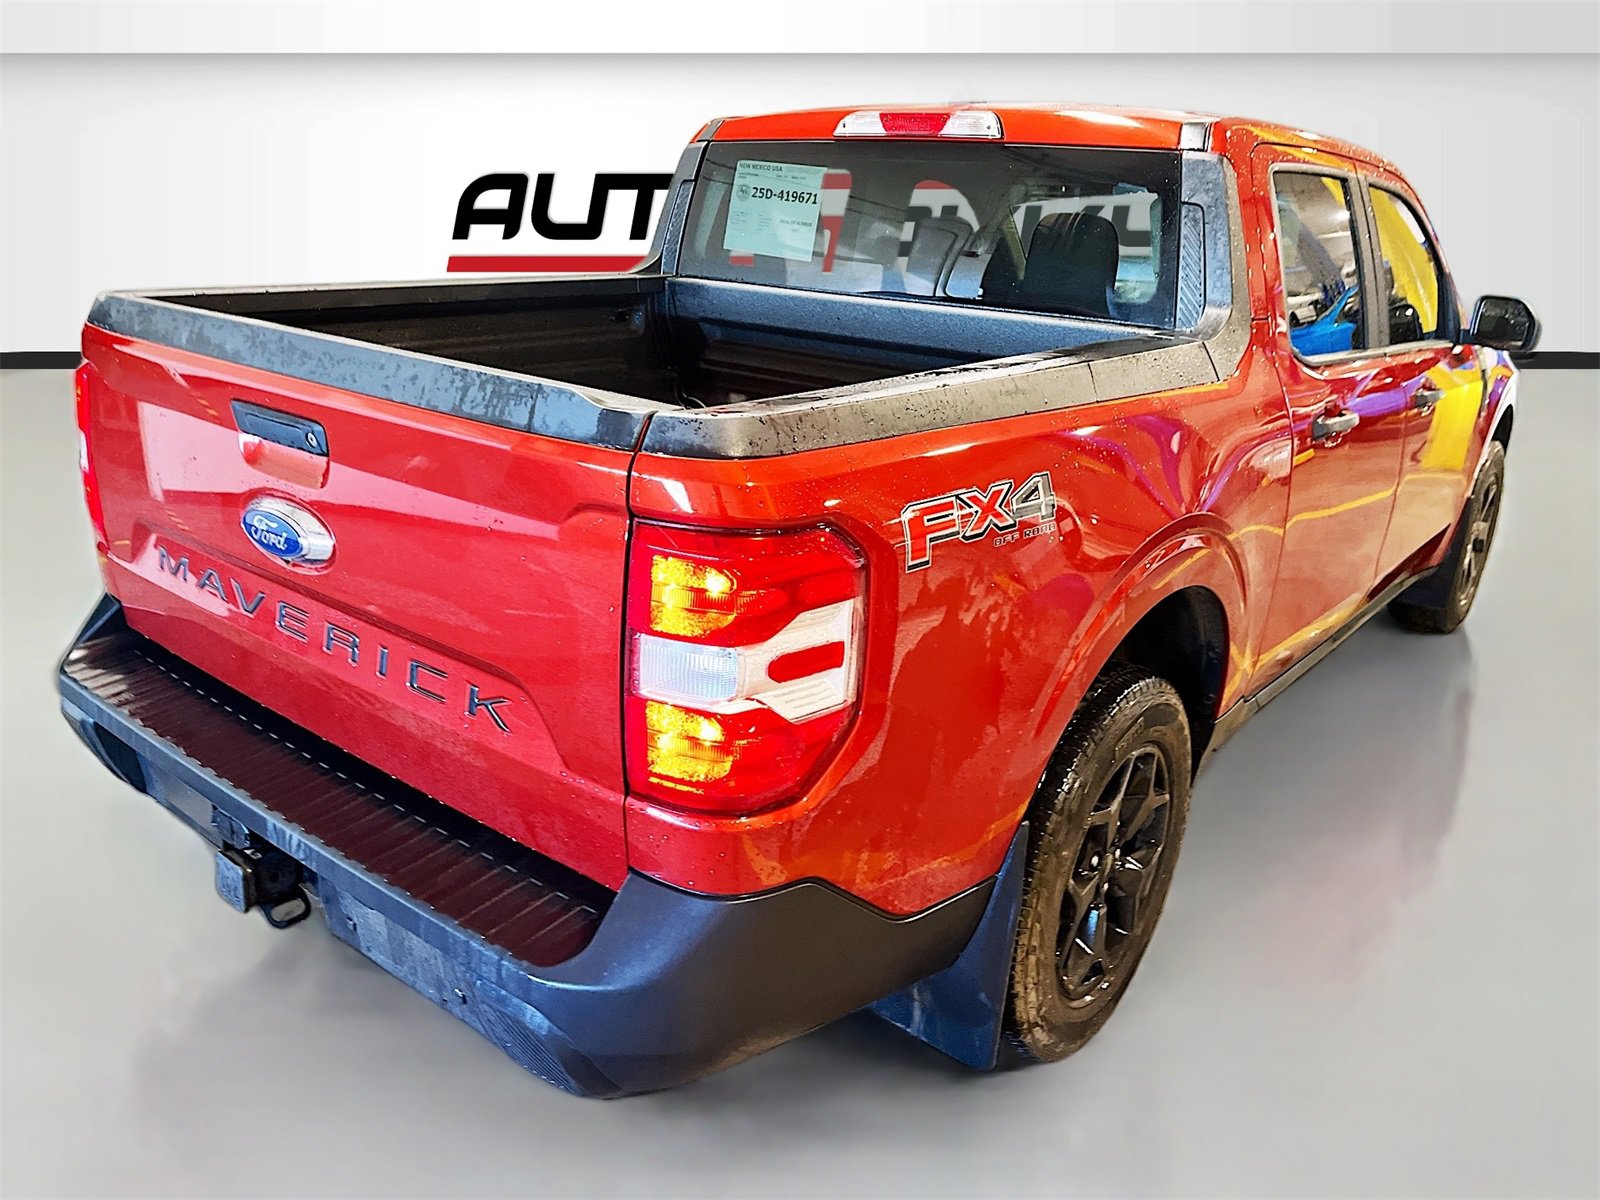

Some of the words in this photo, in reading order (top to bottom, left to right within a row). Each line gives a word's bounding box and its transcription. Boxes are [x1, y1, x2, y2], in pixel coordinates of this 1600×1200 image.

[739, 162, 751, 170] NEW
[751, 163, 772, 172] MEXICO
[772, 165, 783, 173] USA
[751, 186, 818, 205] 25D-419671
[251, 514, 288, 551] Ford
[901, 471, 1057, 573] FX4
[993, 533, 1019, 547] OFF
[1023, 522, 1056, 539] ROAD
[157, 543, 512, 733] MAVERICK
